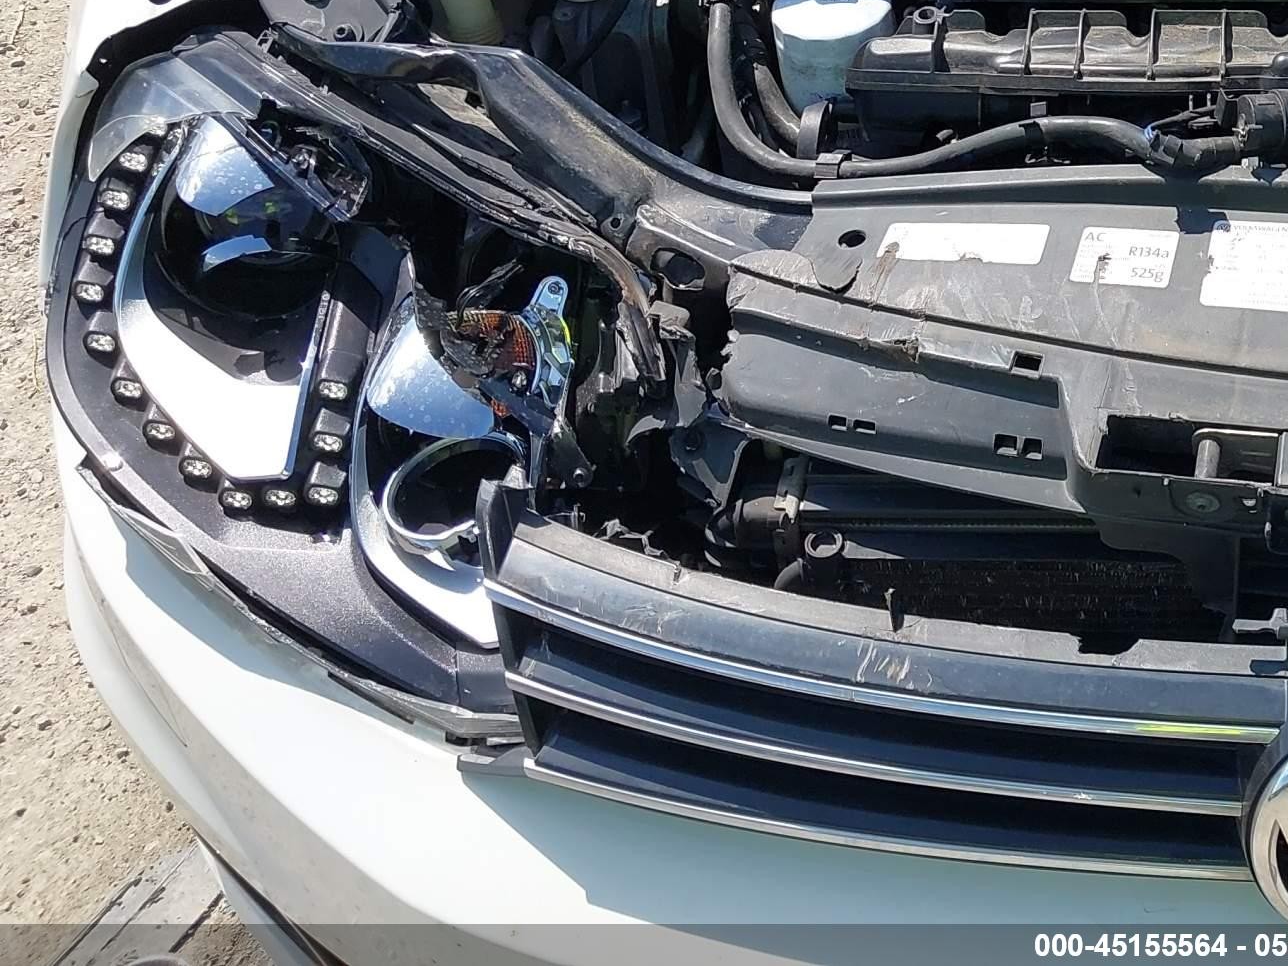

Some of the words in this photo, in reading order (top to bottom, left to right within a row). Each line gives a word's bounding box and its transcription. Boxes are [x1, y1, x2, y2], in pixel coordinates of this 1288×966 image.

[1084, 232, 1107, 242] AC
[1128, 246, 1170, 259] R134a
[1130, 267, 1164, 282] 525g
